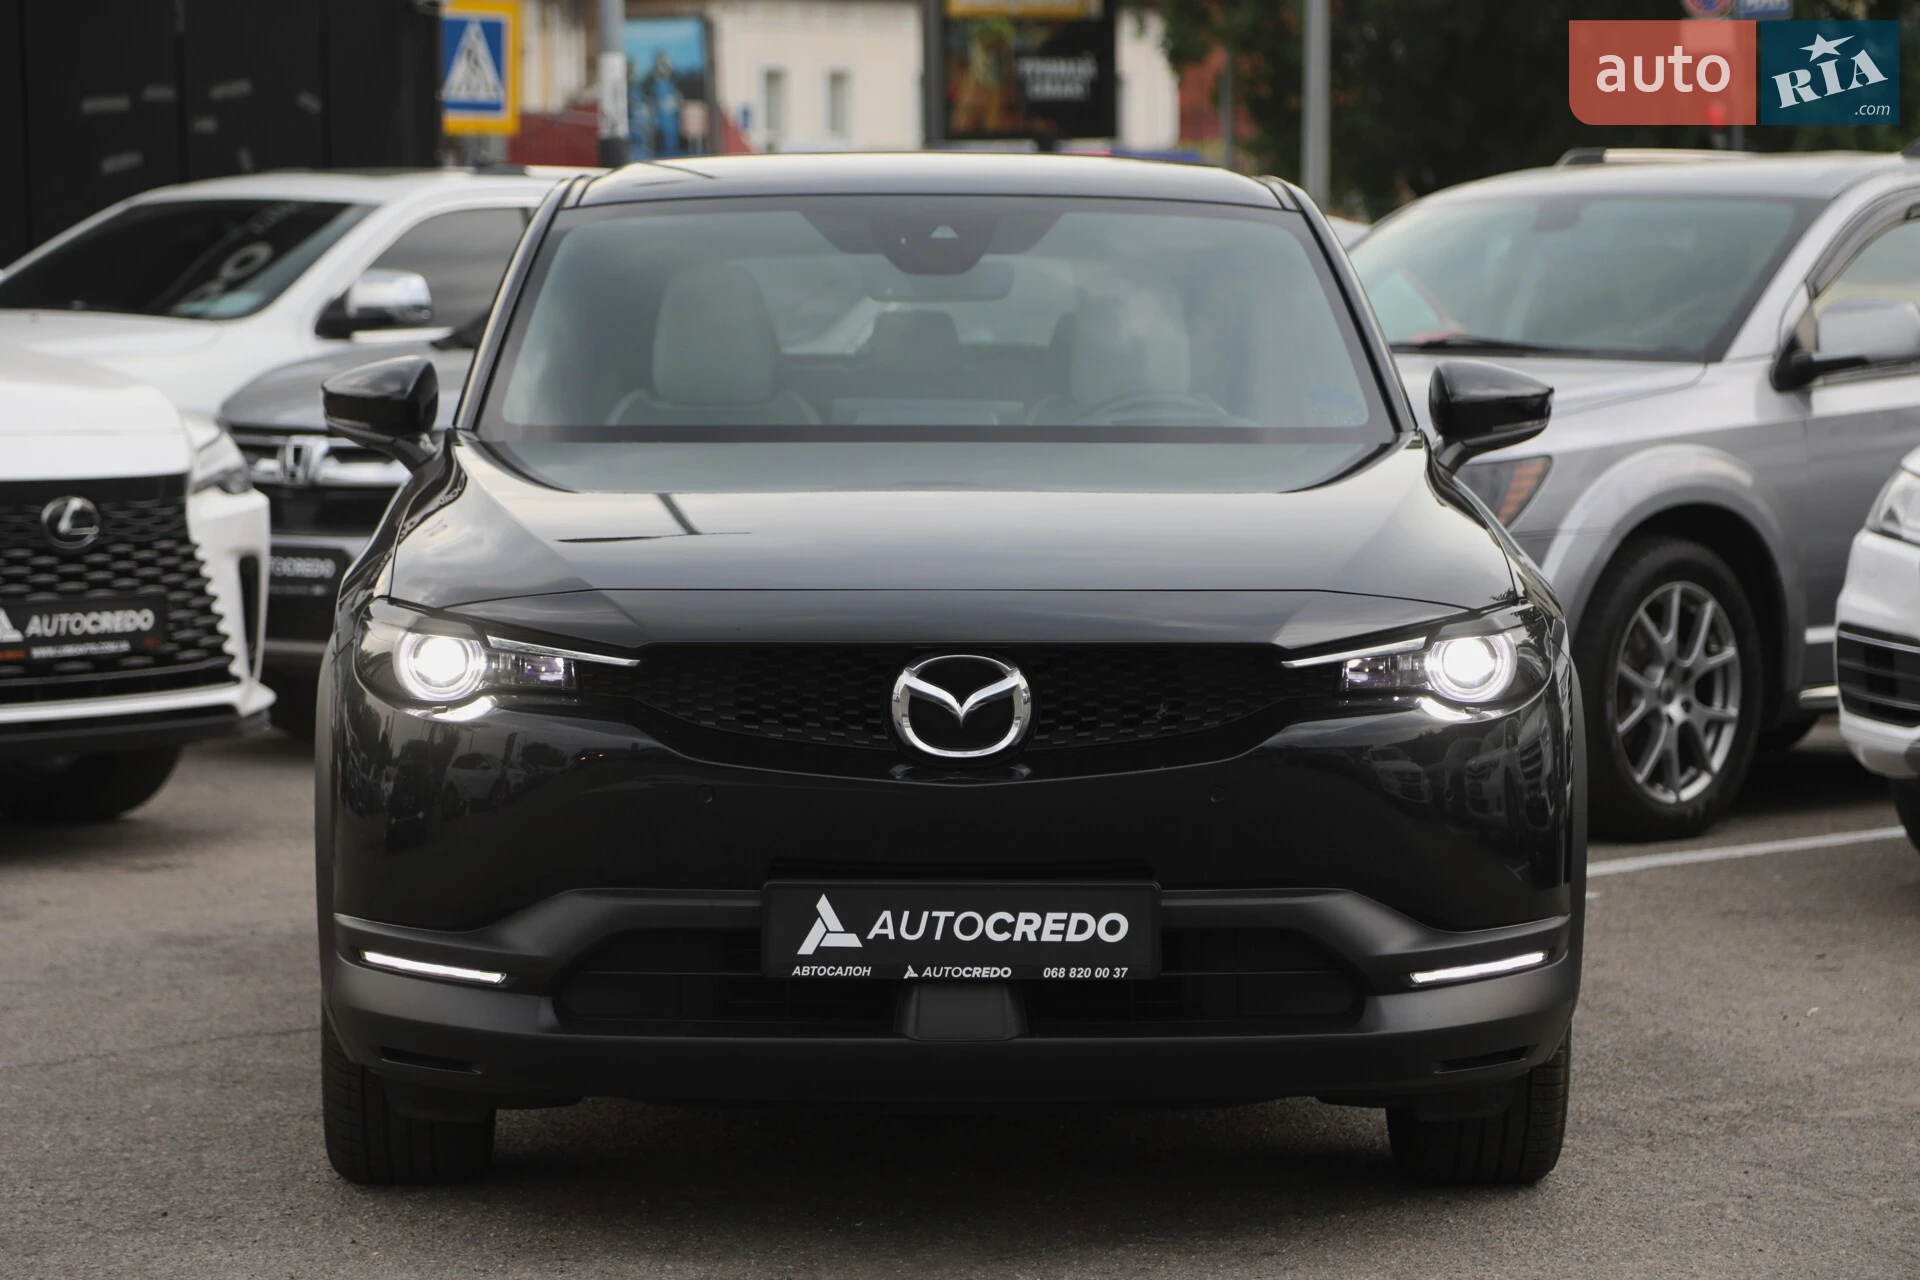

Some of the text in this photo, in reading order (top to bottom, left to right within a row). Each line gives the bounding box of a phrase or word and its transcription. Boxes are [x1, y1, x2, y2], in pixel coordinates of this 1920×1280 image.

[25, 608, 155, 638] AUTOCREDO
[866, 910, 1129, 943] AUTOCREDO
[791, 965, 872, 977] АВТОСАЛОН
[921, 966, 1012, 979] AUTOCREDO
[1043, 967, 1129, 979] 068 820 00 37
